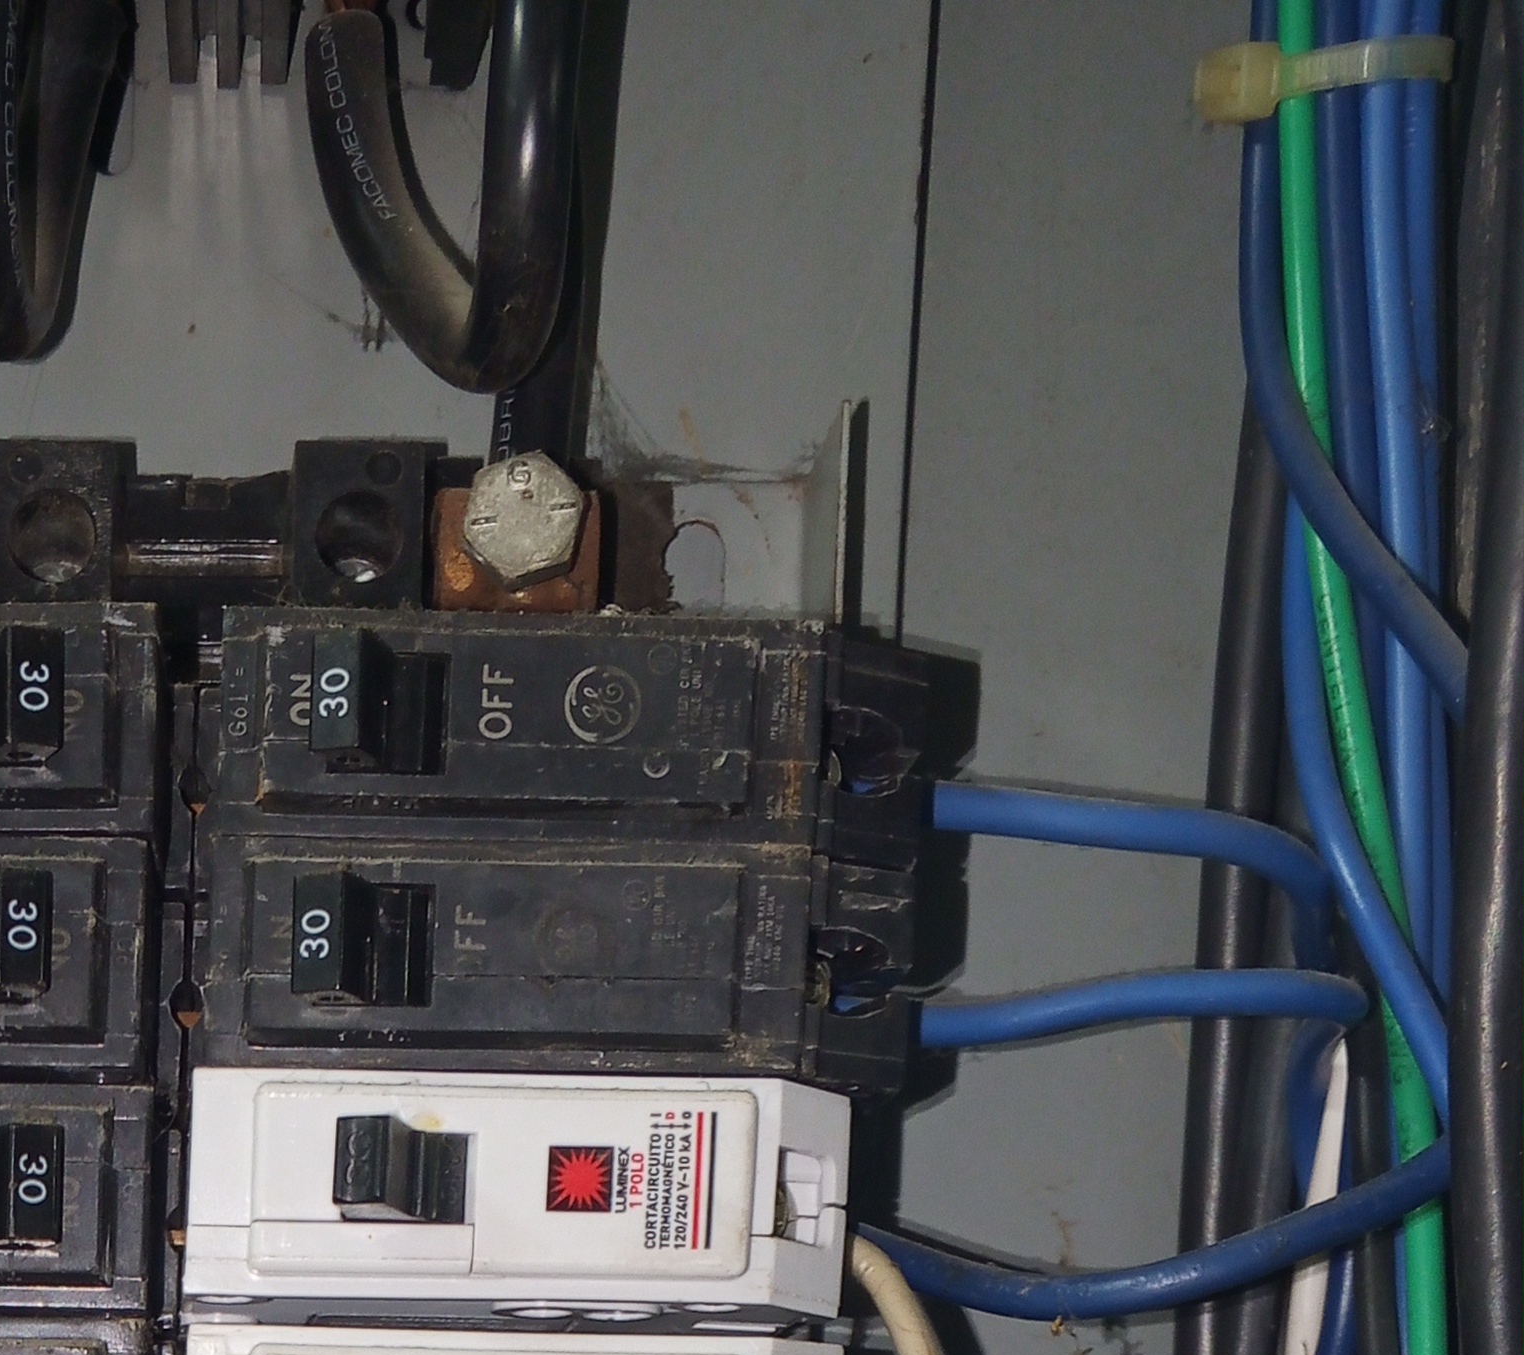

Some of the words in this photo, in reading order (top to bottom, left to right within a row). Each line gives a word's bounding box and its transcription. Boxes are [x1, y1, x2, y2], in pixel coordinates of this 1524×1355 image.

[336, 114, 398, 220] FACOMEC
[19, 660, 50, 712] 30
[319, 667, 350, 719] 30
[478, 664, 515, 741] OFF
[8, 898, 38, 951] 30
[300, 907, 330, 960] 30
[665, 1112, 675, 1120] D
[679, 1133, 692, 1152] kA
[17, 1151, 47, 1206] 30
[614, 1146, 630, 1214] LUMINEX
[629, 1153, 644, 1195] POLO
[644, 1133, 661, 1249] CORTACIRCUITO
[674, 1194, 688, 1250] 120/240
